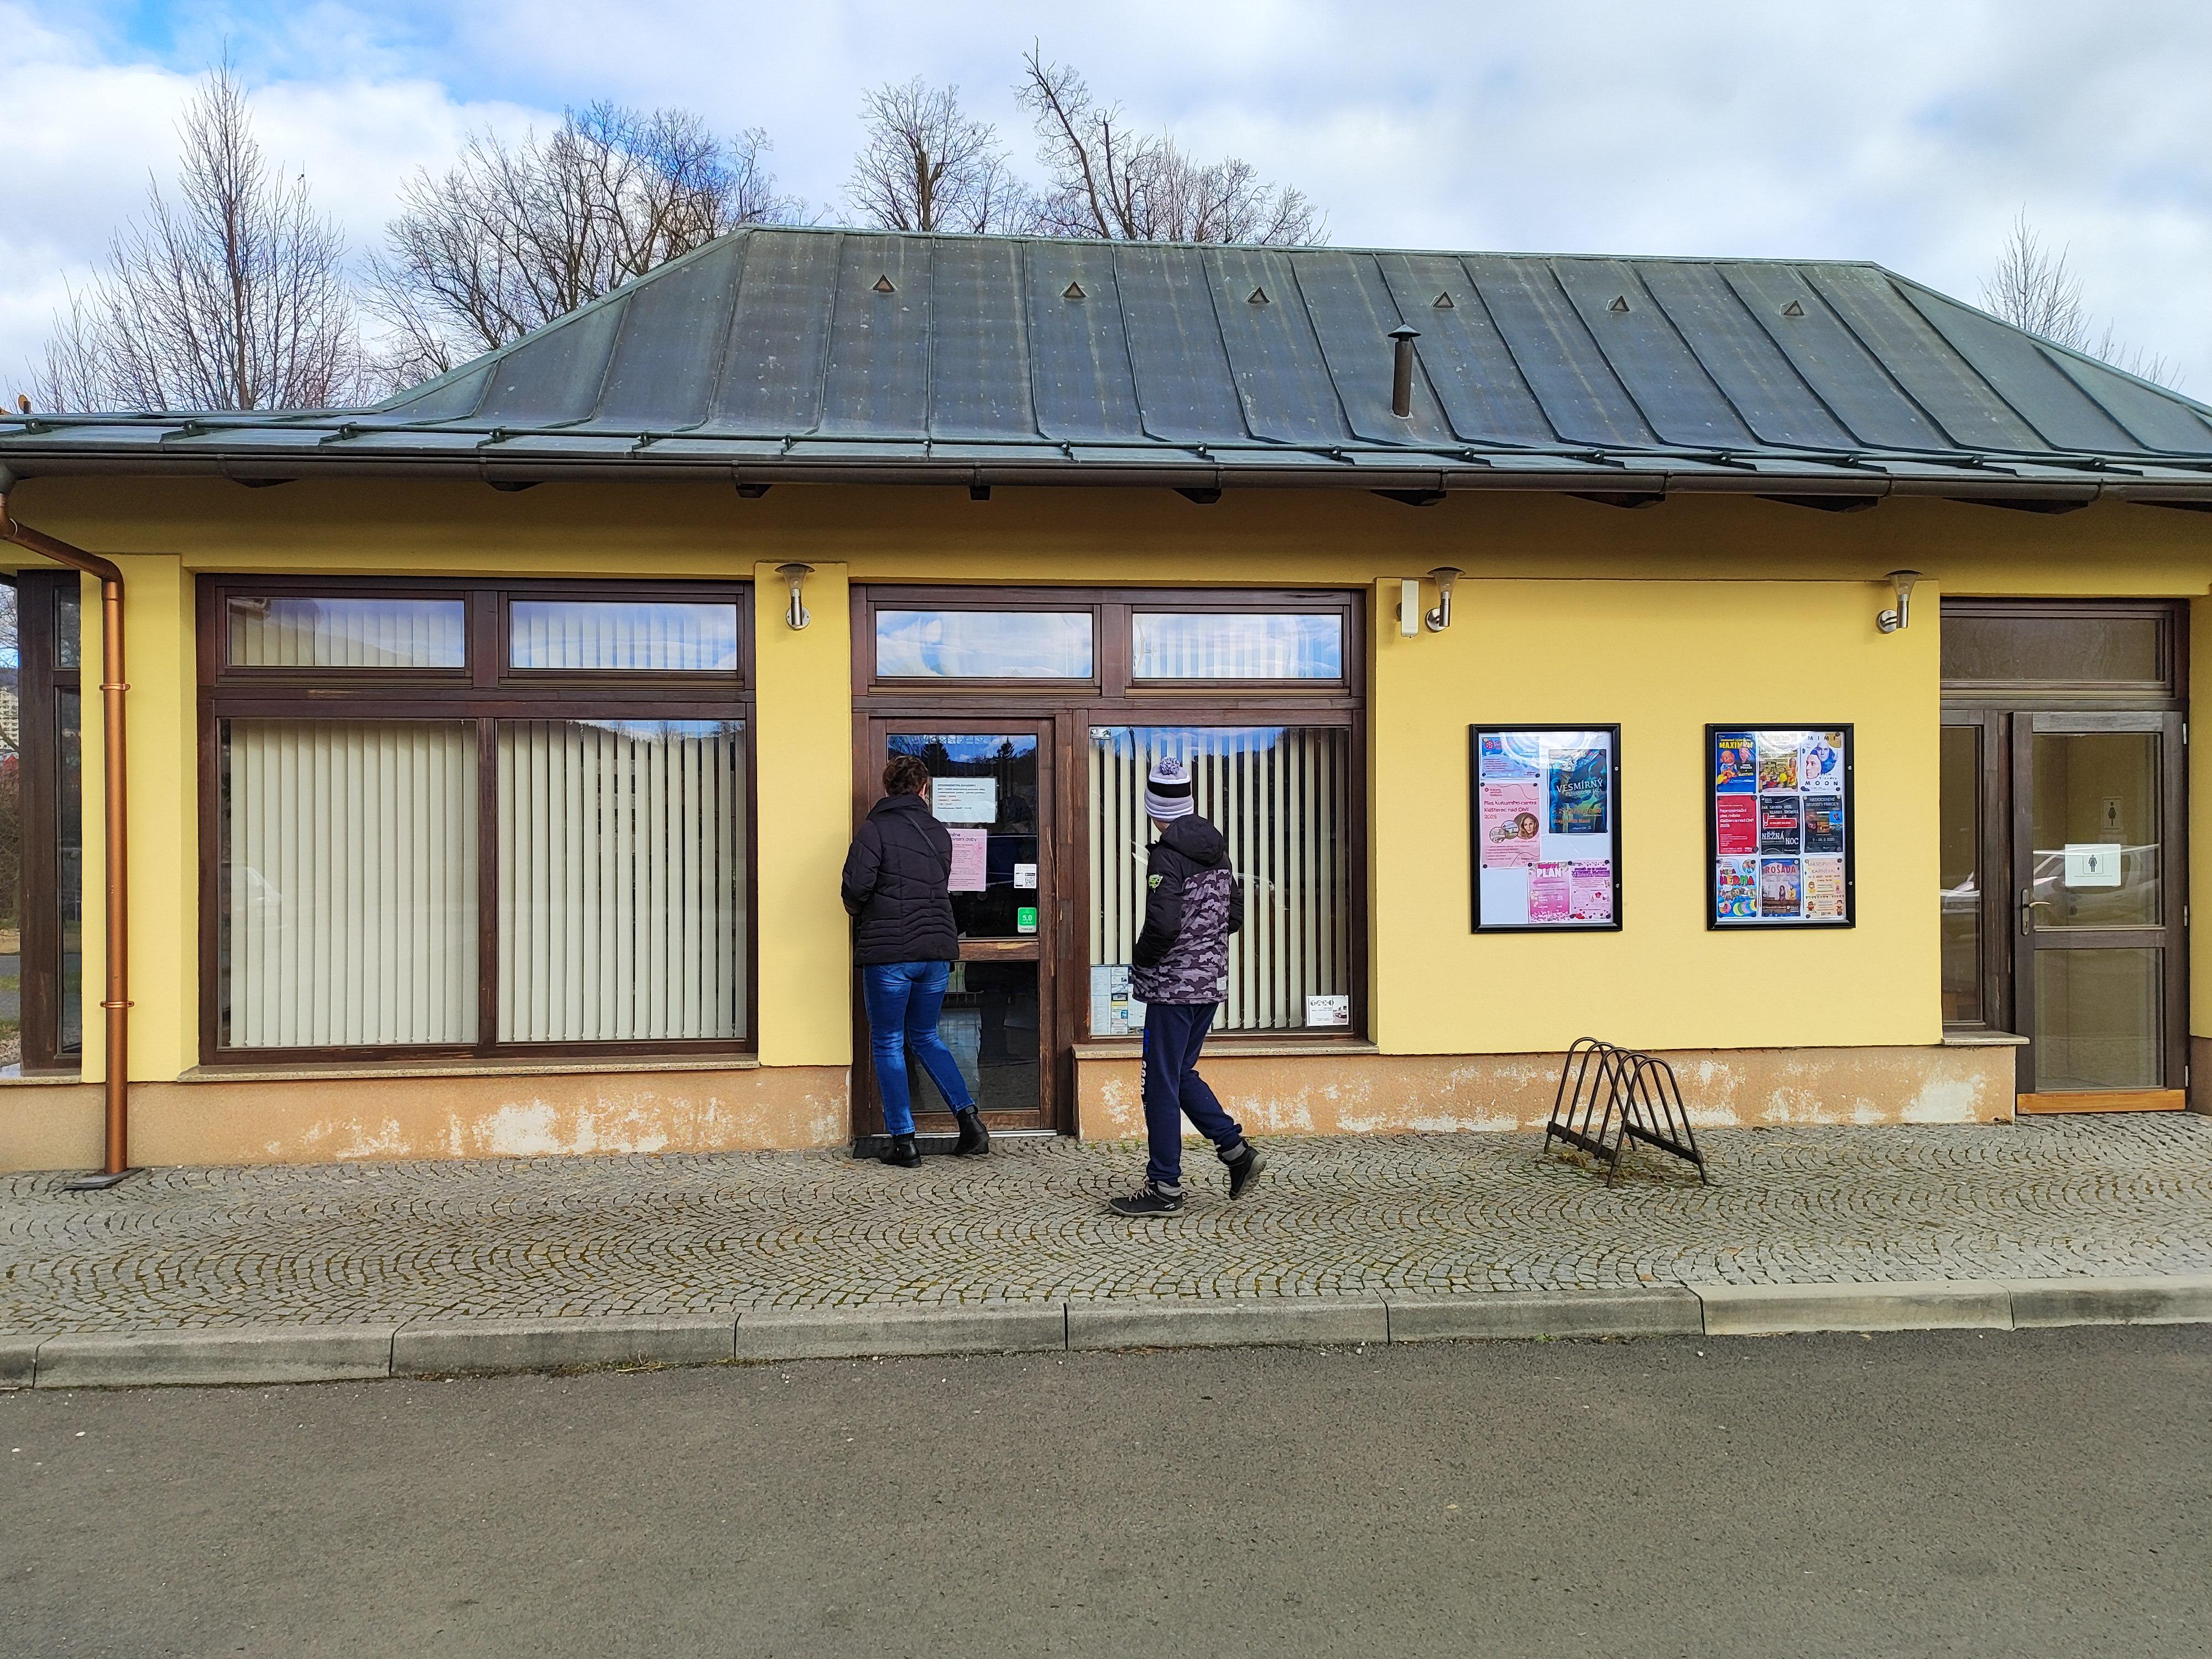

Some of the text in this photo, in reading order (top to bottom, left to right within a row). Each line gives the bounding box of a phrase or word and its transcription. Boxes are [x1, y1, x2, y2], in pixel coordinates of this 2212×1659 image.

[1556, 777, 1603, 792] VESMÍRNÝ
[1761, 831, 1785, 841] NĚŽNÁ
[1720, 875, 1755, 886] HERNA
